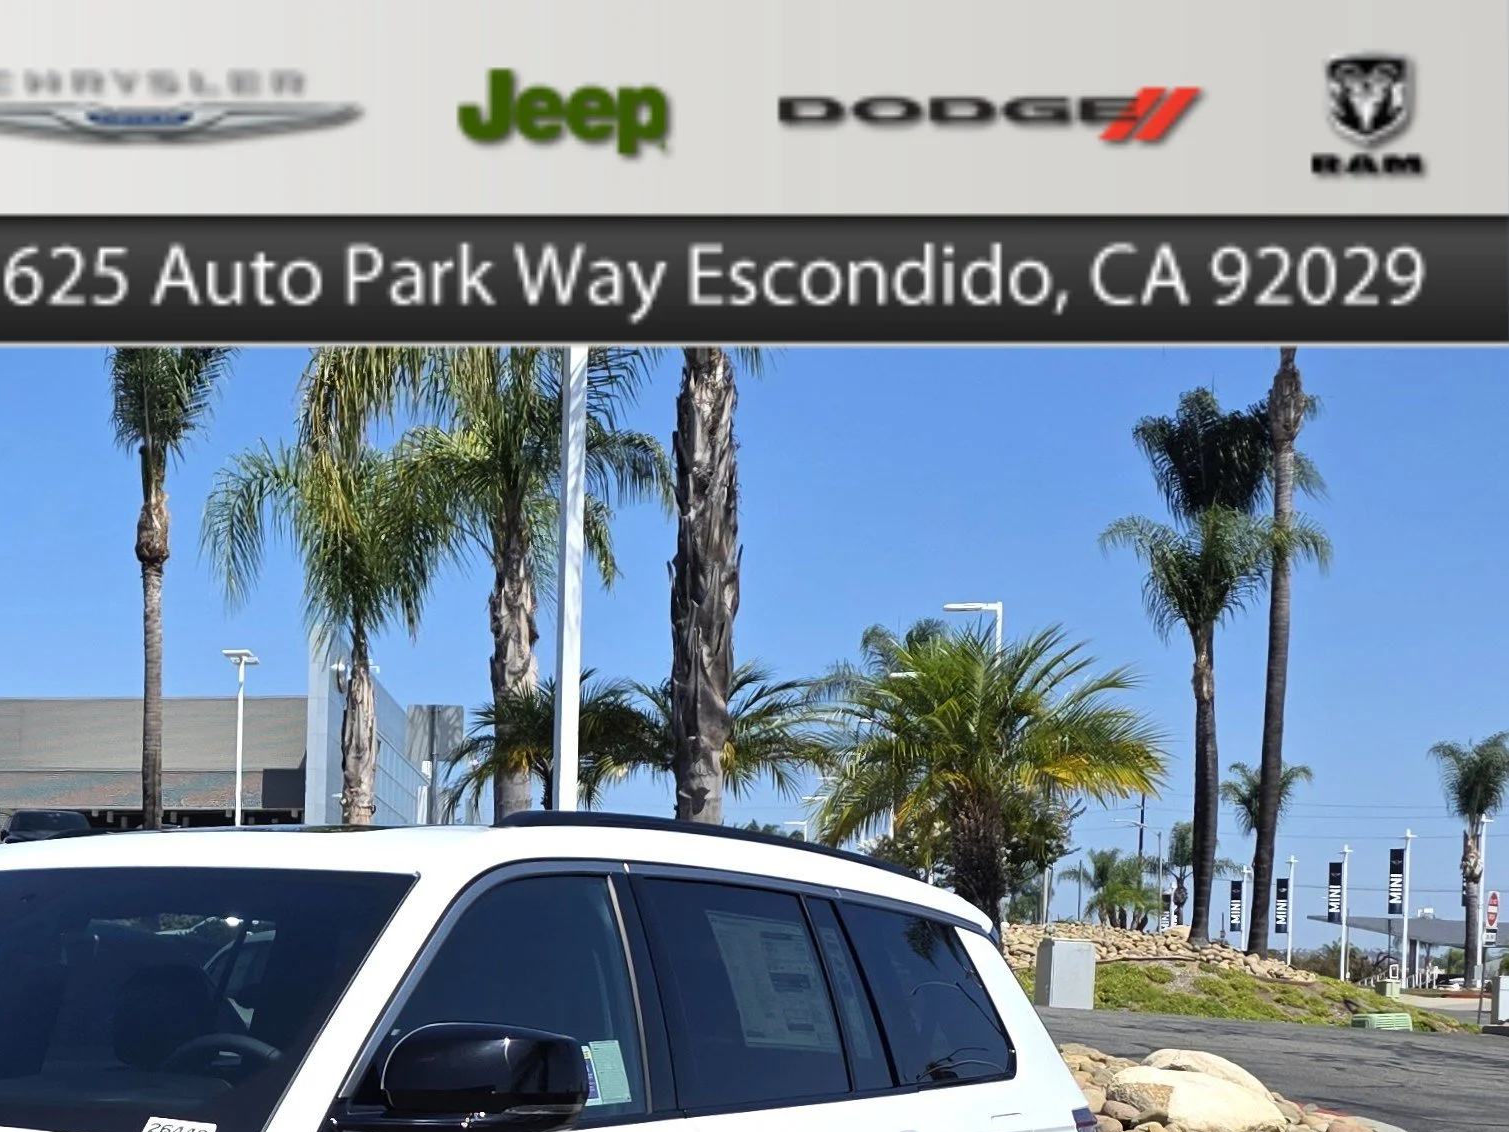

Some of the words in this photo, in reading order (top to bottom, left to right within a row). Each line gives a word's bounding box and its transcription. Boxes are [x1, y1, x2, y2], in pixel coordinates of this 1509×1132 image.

[1328, 885, 1342, 913] MINI
[1388, 873, 1403, 904] MINI
[1230, 899, 1242, 924] MINI
[1276, 899, 1288, 925] MINI
